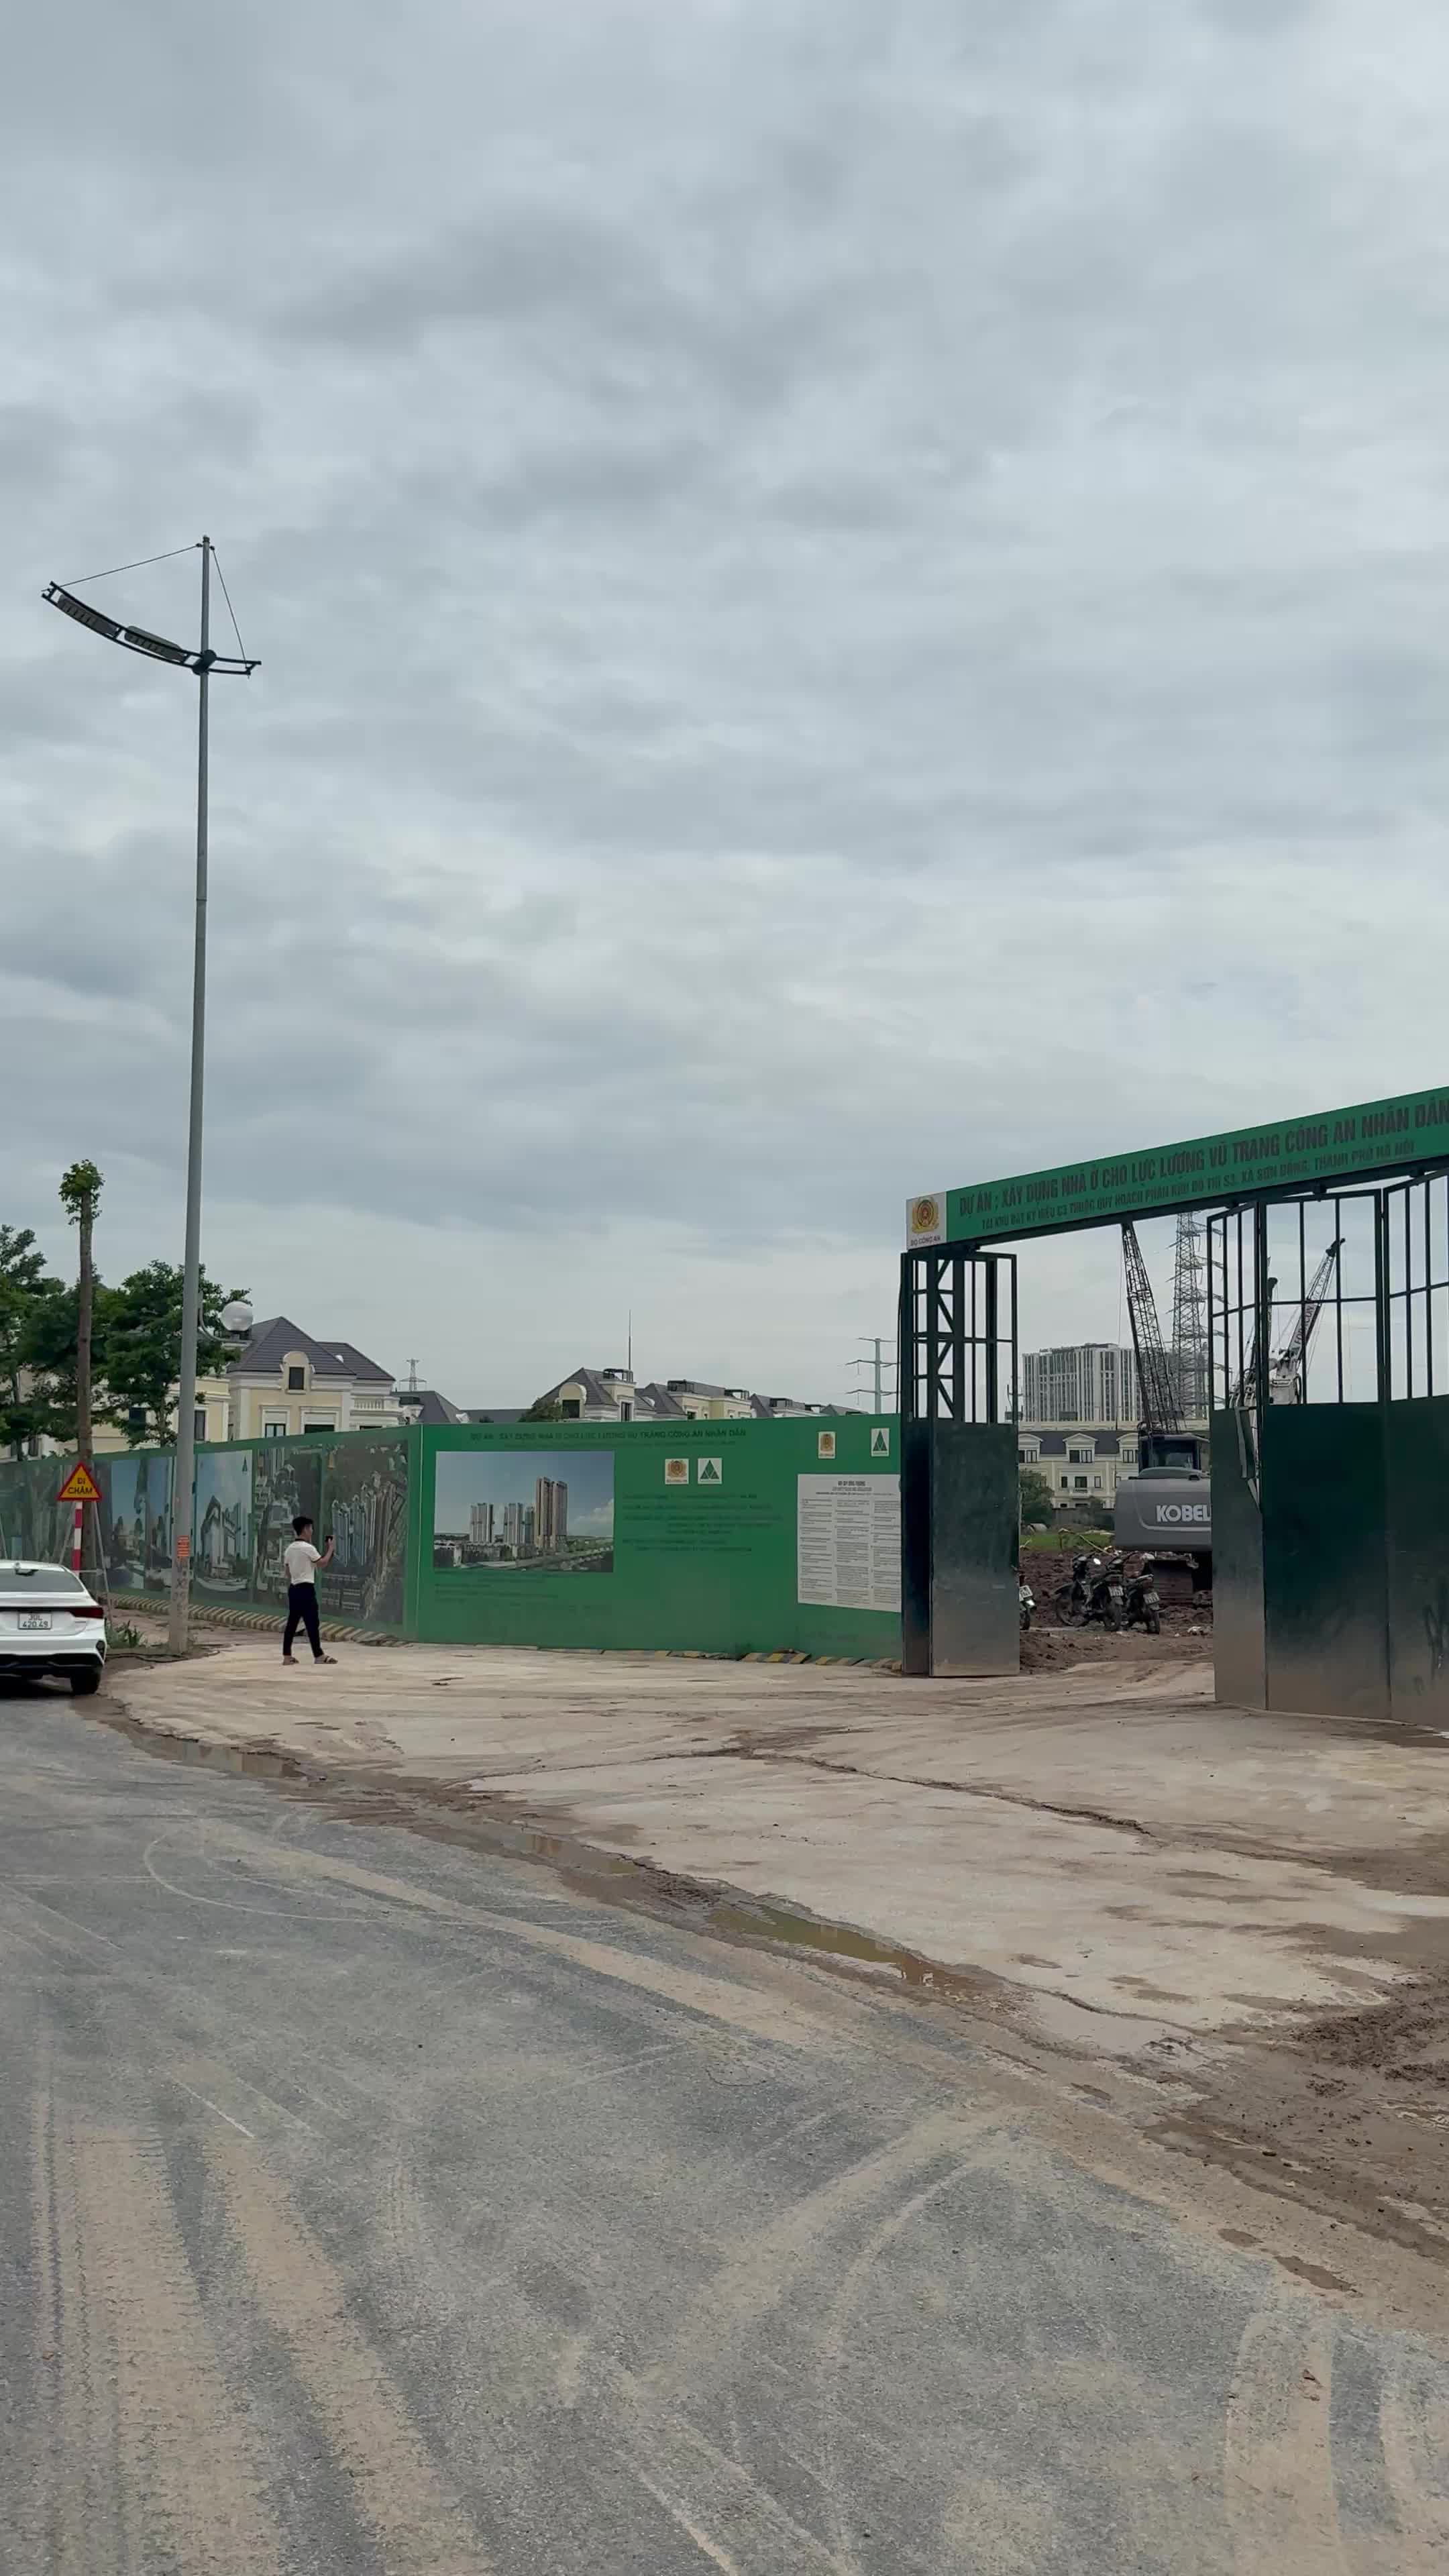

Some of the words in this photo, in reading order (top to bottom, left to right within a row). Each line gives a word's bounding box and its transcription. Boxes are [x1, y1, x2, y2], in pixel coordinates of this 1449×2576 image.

[959, 1195, 974, 1218] DỰ
[977, 1190, 991, 1214] ÁN
[1002, 1185, 1023, 1208] XÂY
[1026, 1178, 1058, 1205] DỰNG
[1062, 1169, 1086, 1197] NHÀ
[1090, 1165, 1099, 1190] Ở
[1102, 1164, 1128, 1188] CHO
[1132, 1159, 1156, 1185] LỰC
[1160, 1148, 1205, 1179] LƯỢNG
[1209, 1142, 1228, 1168] VŨ
[1232, 1134, 1280, 1164] TRANG
[1285, 1124, 1328, 1153] CÔNG
[1333, 1117, 1356, 1144] AN
[1362, 1106, 1409, 1138] NHÂN
[1415, 1095, 1449, 1128] DÂN
